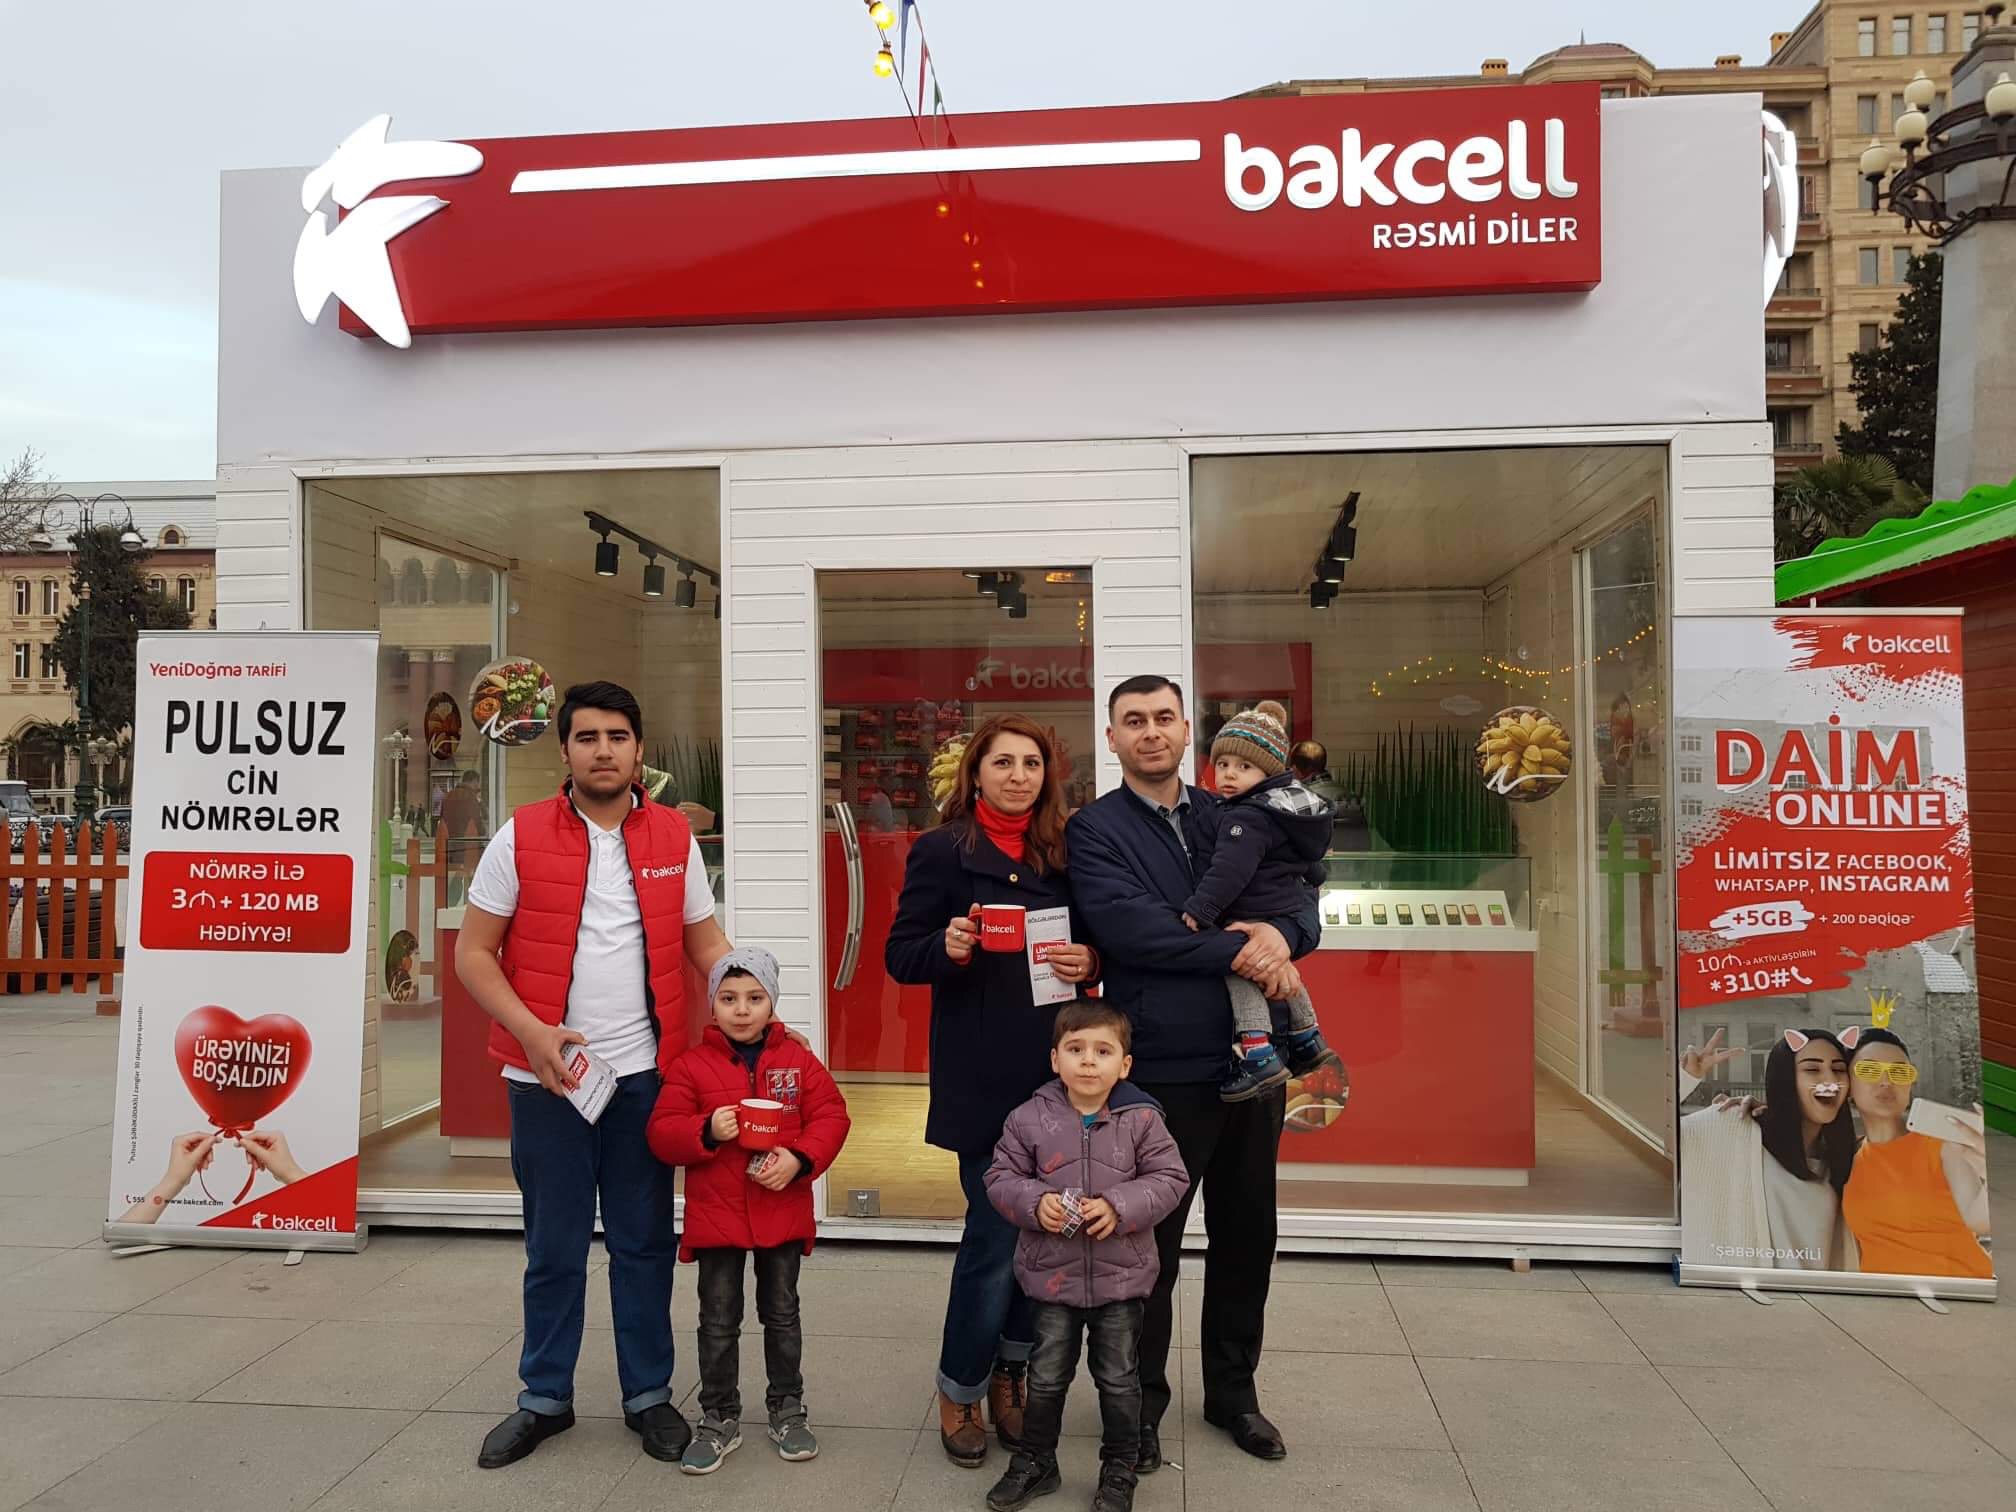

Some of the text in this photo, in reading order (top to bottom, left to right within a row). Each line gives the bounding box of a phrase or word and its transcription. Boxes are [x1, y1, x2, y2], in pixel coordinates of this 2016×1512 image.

[1224, 118, 1578, 211] bakcell
[1373, 212, 1578, 249] RƏSMİ DİLER
[1868, 635, 1951, 653] bakcell
[246, 662, 286, 677] TARİFİ
[165, 700, 346, 756] PULSUZ
[1715, 714, 1921, 792] DAİM
[227, 765, 278, 795] CİN
[161, 801, 340, 833] NÖMRƏLƏR
[1775, 794, 1942, 826] ONLINE
[190, 859, 304, 880] NÖMRƏ İLƏ
[1714, 847, 1952, 872] LİMİTSİZ FACEBOOK,
[1715, 876, 1950, 894] WHATSAPP, INSTAGRAM
[239, 894, 280, 911] 120
[285, 895, 319, 911] MB
[986, 923, 1015, 933] bakcell
[1732, 911, 1793, 926] +5GB
[1832, 914, 1855, 924] 200
[200, 923, 291, 942] HƏDİYYƏ!
[194, 1036, 291, 1064] ÜRƏYİNİZİ
[193, 1060, 288, 1090] BOŞALDIN
[752, 1123, 778, 1132] bakcell
[164, 1198, 224, 1207] www.bakcell.com
[272, 1214, 338, 1231] bakcell
